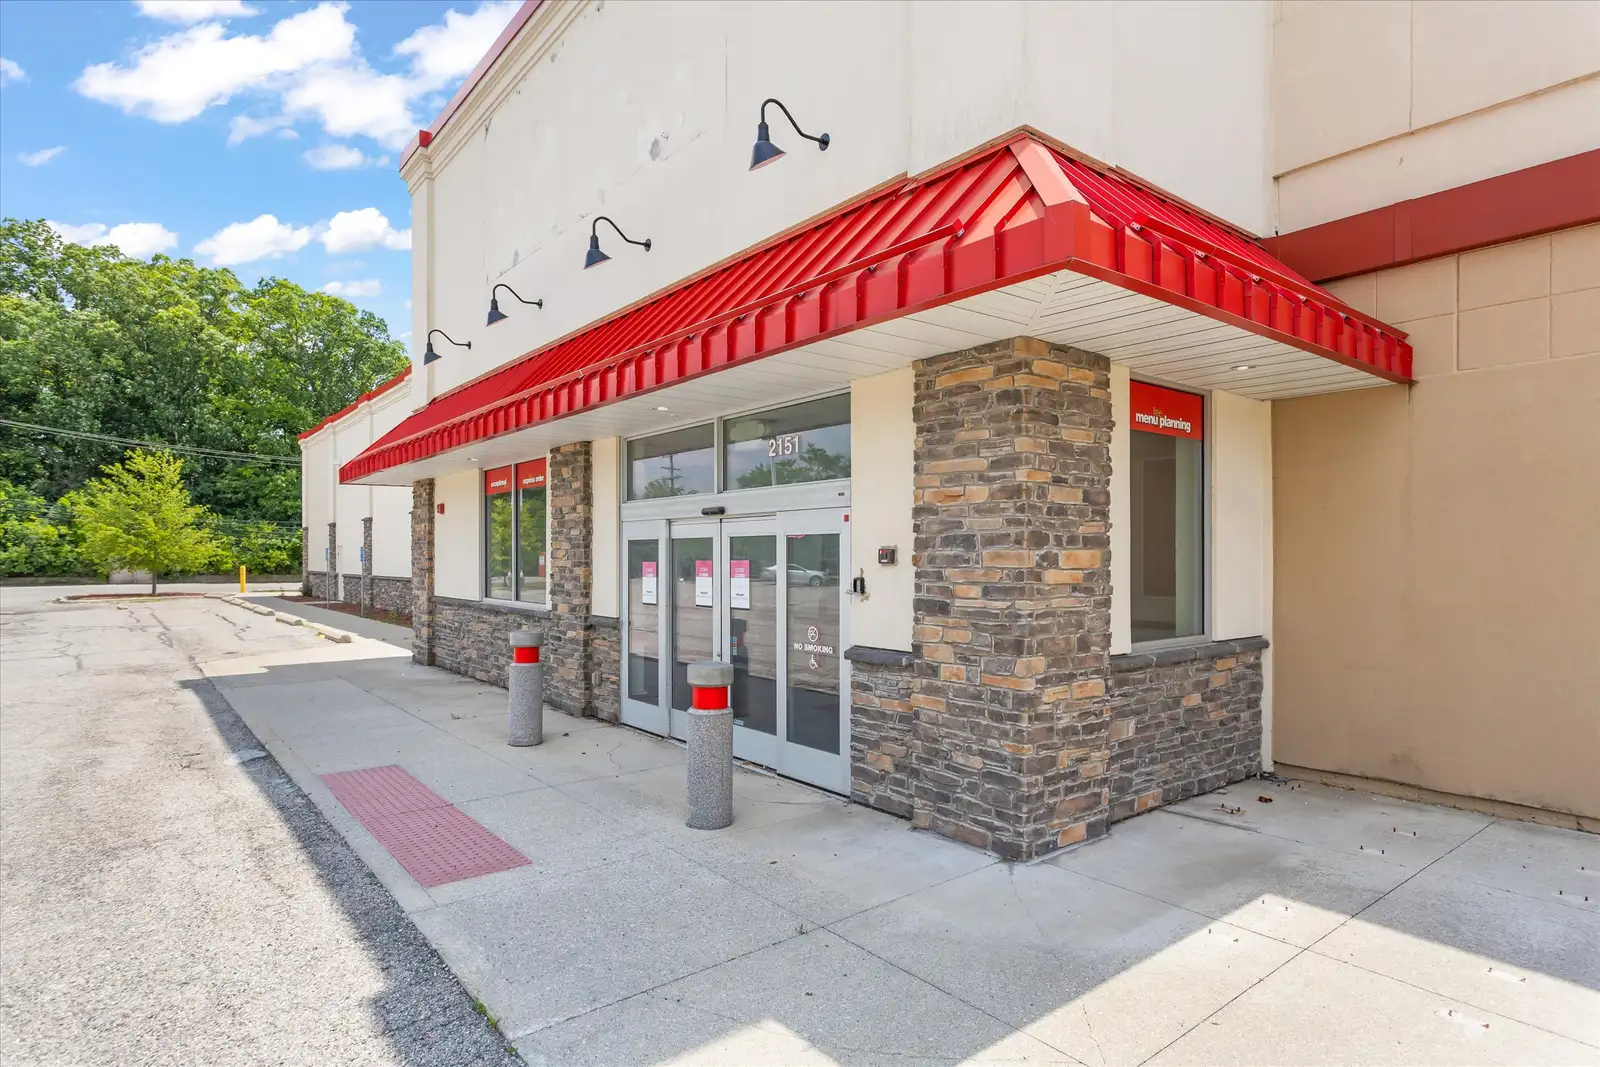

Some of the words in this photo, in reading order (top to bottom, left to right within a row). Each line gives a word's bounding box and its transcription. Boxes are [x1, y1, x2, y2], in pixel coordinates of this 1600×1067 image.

[1135, 412, 1158, 425] menu
[1159, 415, 1191, 433] planning
[768, 434, 799, 457] 2151
[793, 642, 803, 650] NO
[804, 643, 833, 654] SMOKING
